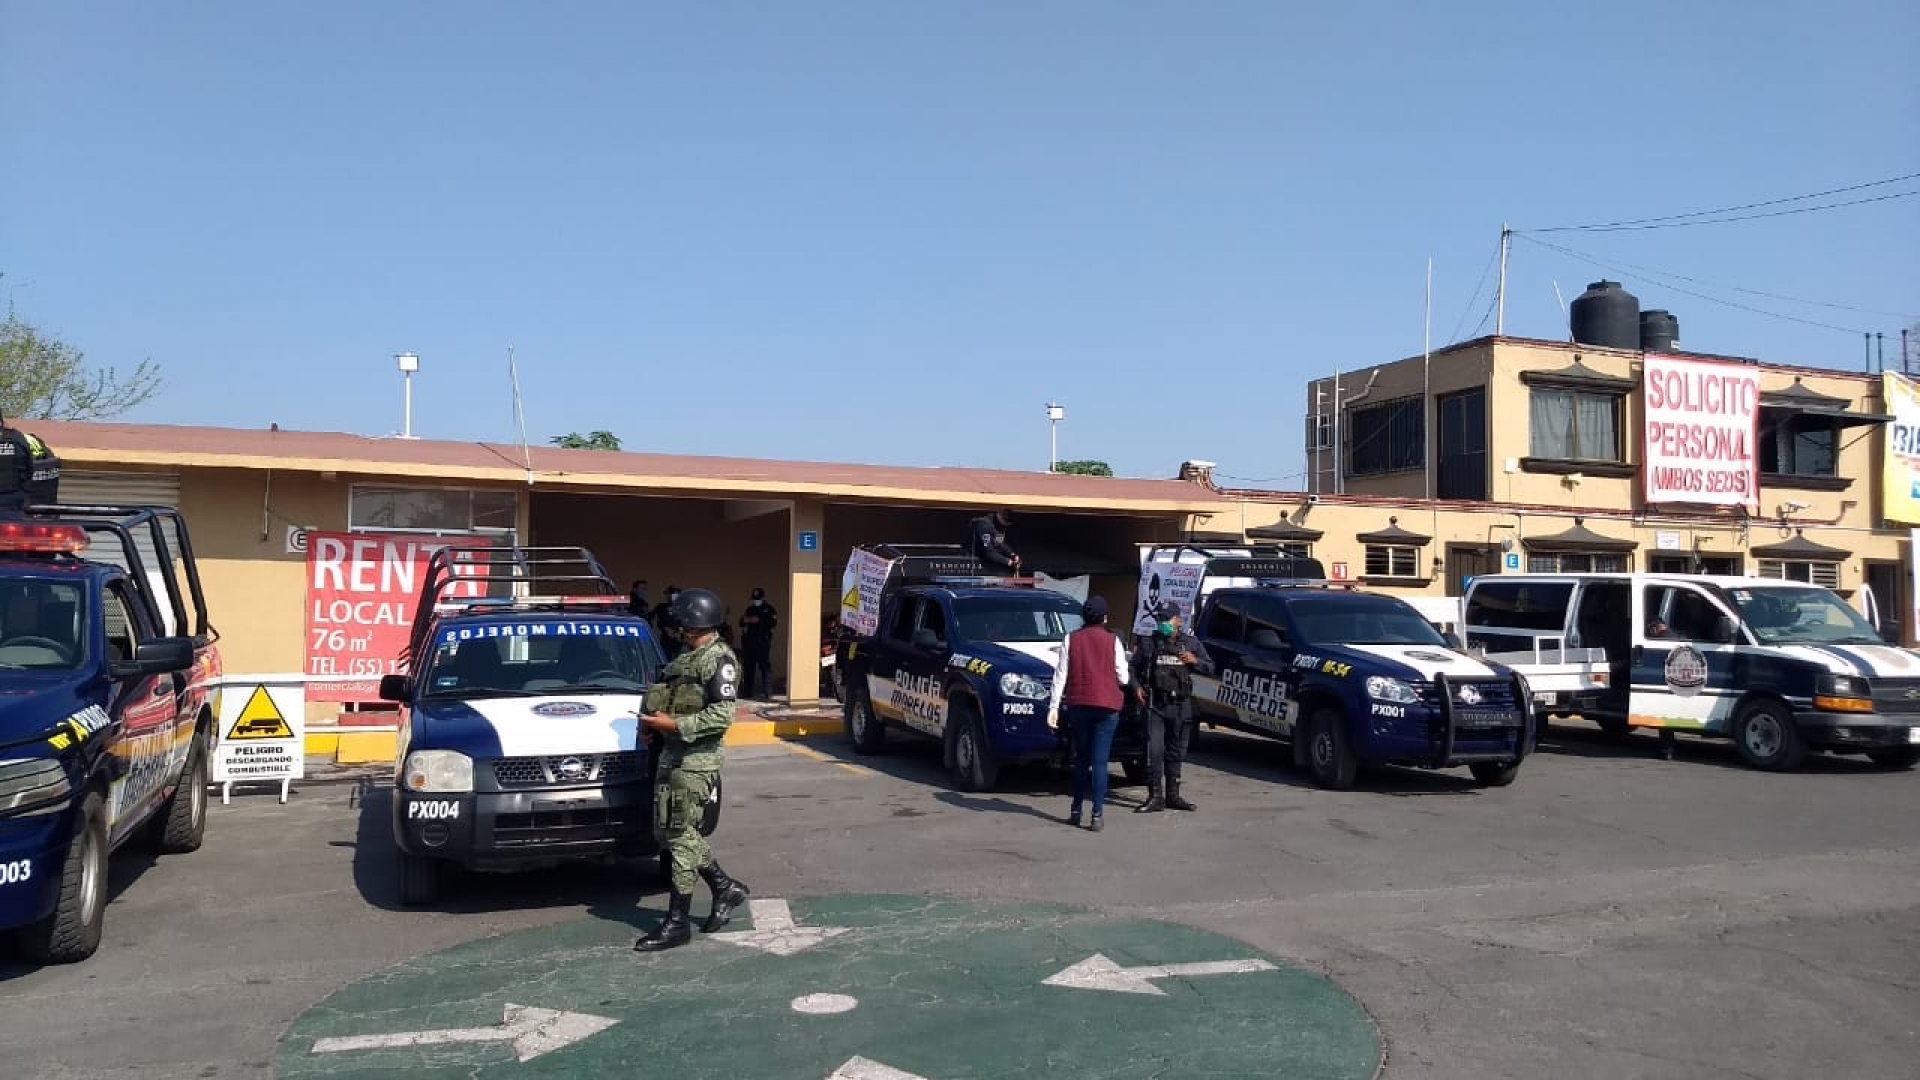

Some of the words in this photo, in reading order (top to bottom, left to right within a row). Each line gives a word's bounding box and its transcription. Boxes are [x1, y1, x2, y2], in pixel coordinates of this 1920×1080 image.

[1648, 368, 1758, 416] SOLICITO
[313, 600, 412, 626] LOCAL
[312, 630, 346, 652] 76
[311, 656, 344, 675] TEL.
[349, 658, 382, 676] (55)
[1003, 703, 1035, 715] PX002
[1371, 703, 1405, 718] PX001
[235, 746, 284, 756] PELIGRO
[408, 800, 460, 819] PX004
